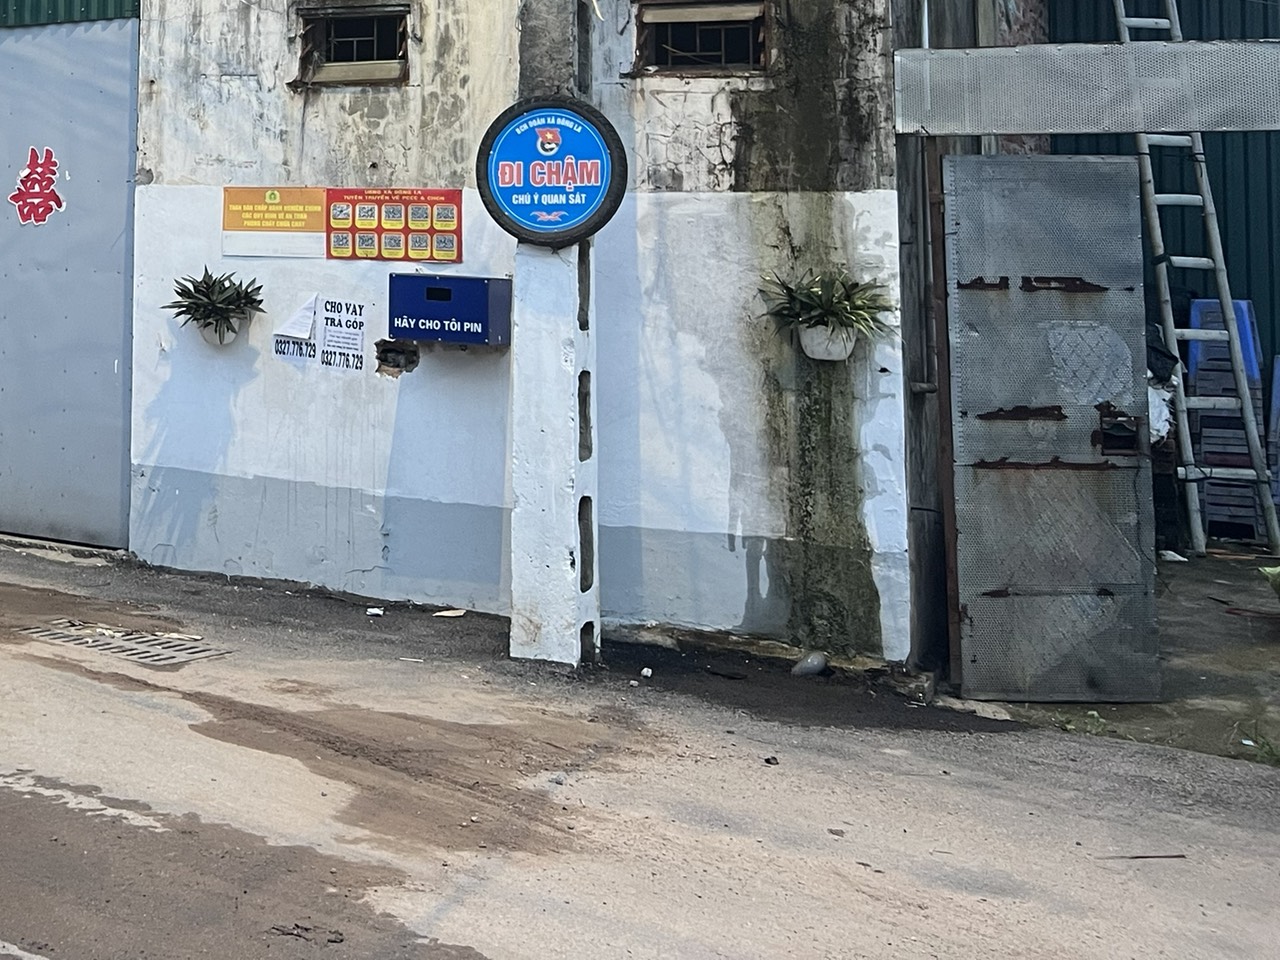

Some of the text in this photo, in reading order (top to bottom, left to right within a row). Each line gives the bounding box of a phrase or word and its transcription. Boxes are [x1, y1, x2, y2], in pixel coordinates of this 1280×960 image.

[498, 155, 601, 192] ĐI CHẬM
[512, 192, 587, 205] CHÚ Ý QUAN SÁT
[324, 300, 365, 317] CHO VAY
[324, 314, 365, 331] TRẢ GÓP
[394, 315, 482, 333] HÃY CHO TÔI PIN
[274, 338, 317, 359] 0327.776.729
[321, 349, 364, 371] 0327.776.729
